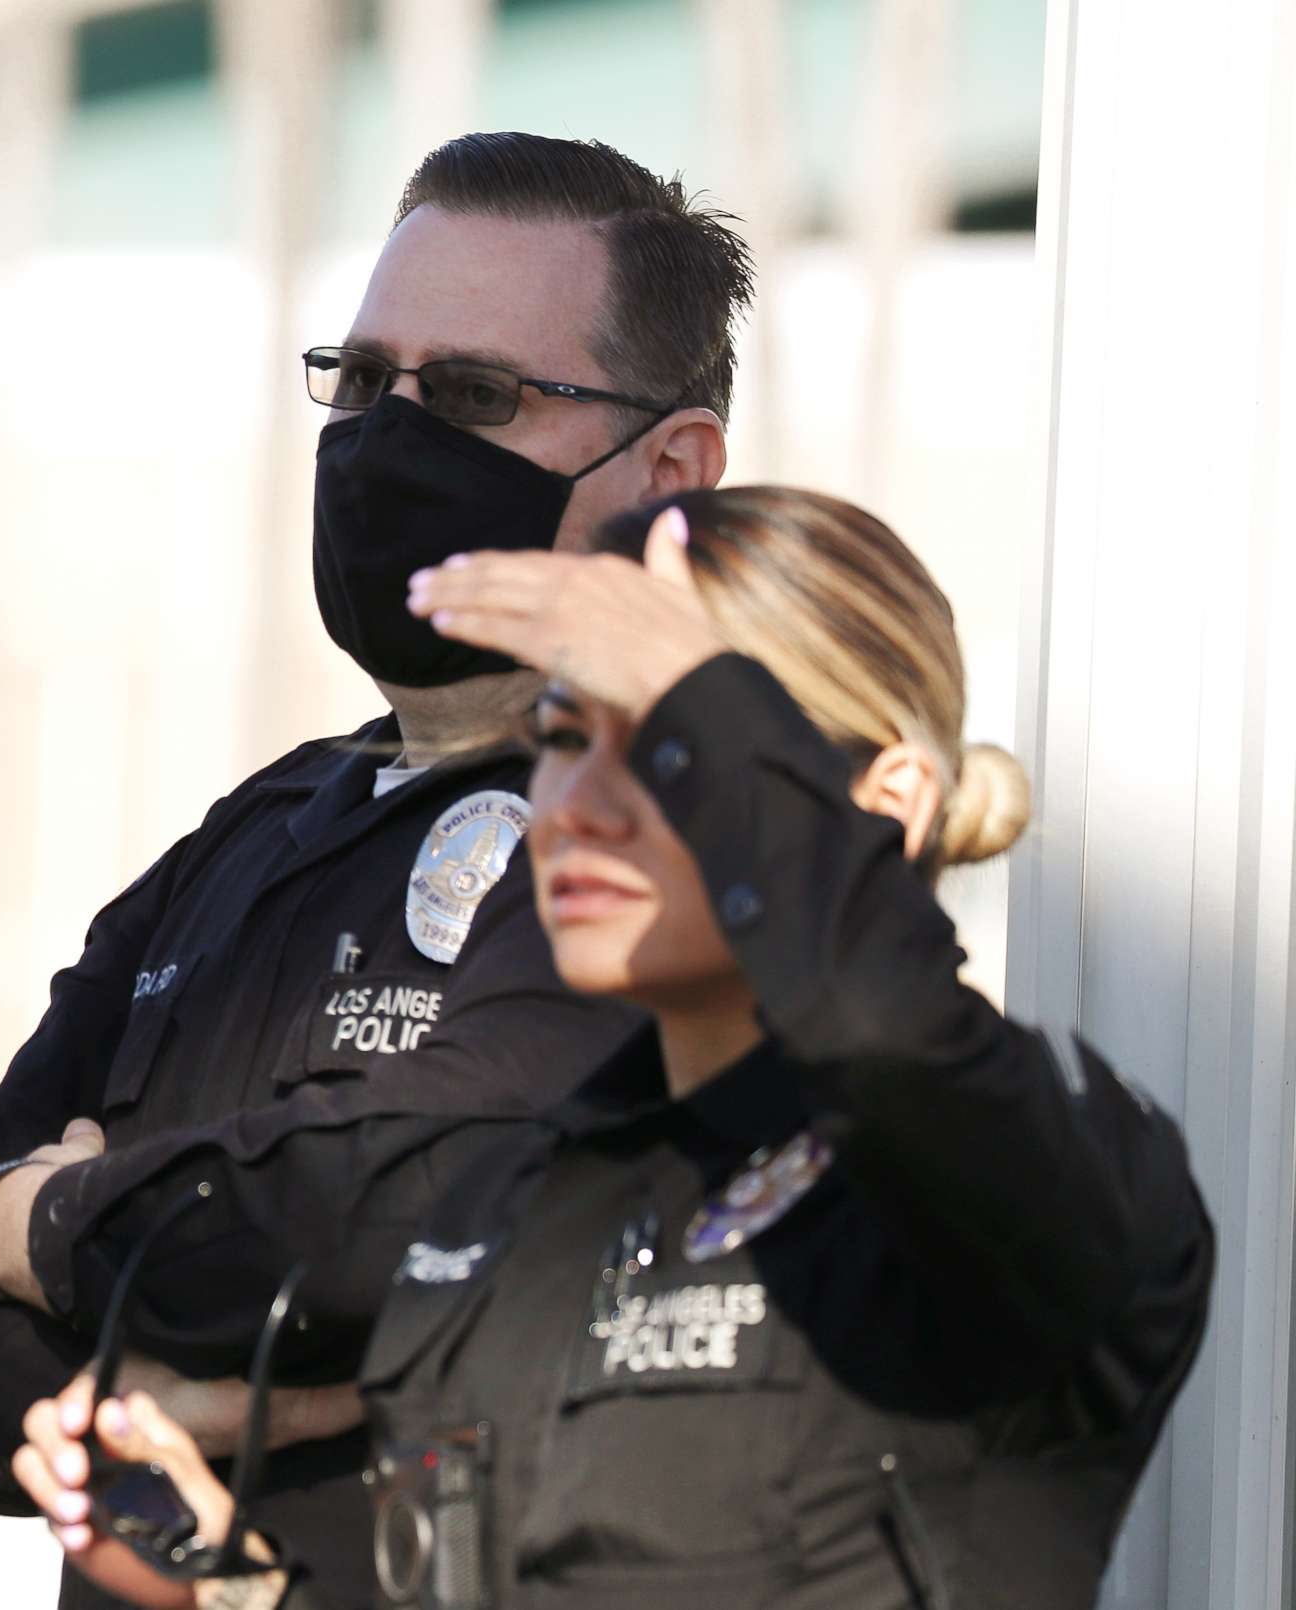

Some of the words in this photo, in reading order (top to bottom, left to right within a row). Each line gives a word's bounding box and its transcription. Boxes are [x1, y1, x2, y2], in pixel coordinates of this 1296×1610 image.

[442, 801, 493, 833] POLICE
[325, 986, 373, 1016] LOS
[372, 986, 443, 1022] ANGE
[647, 1284, 767, 1326] ANGELES
[604, 1322, 739, 1375] POLICE
